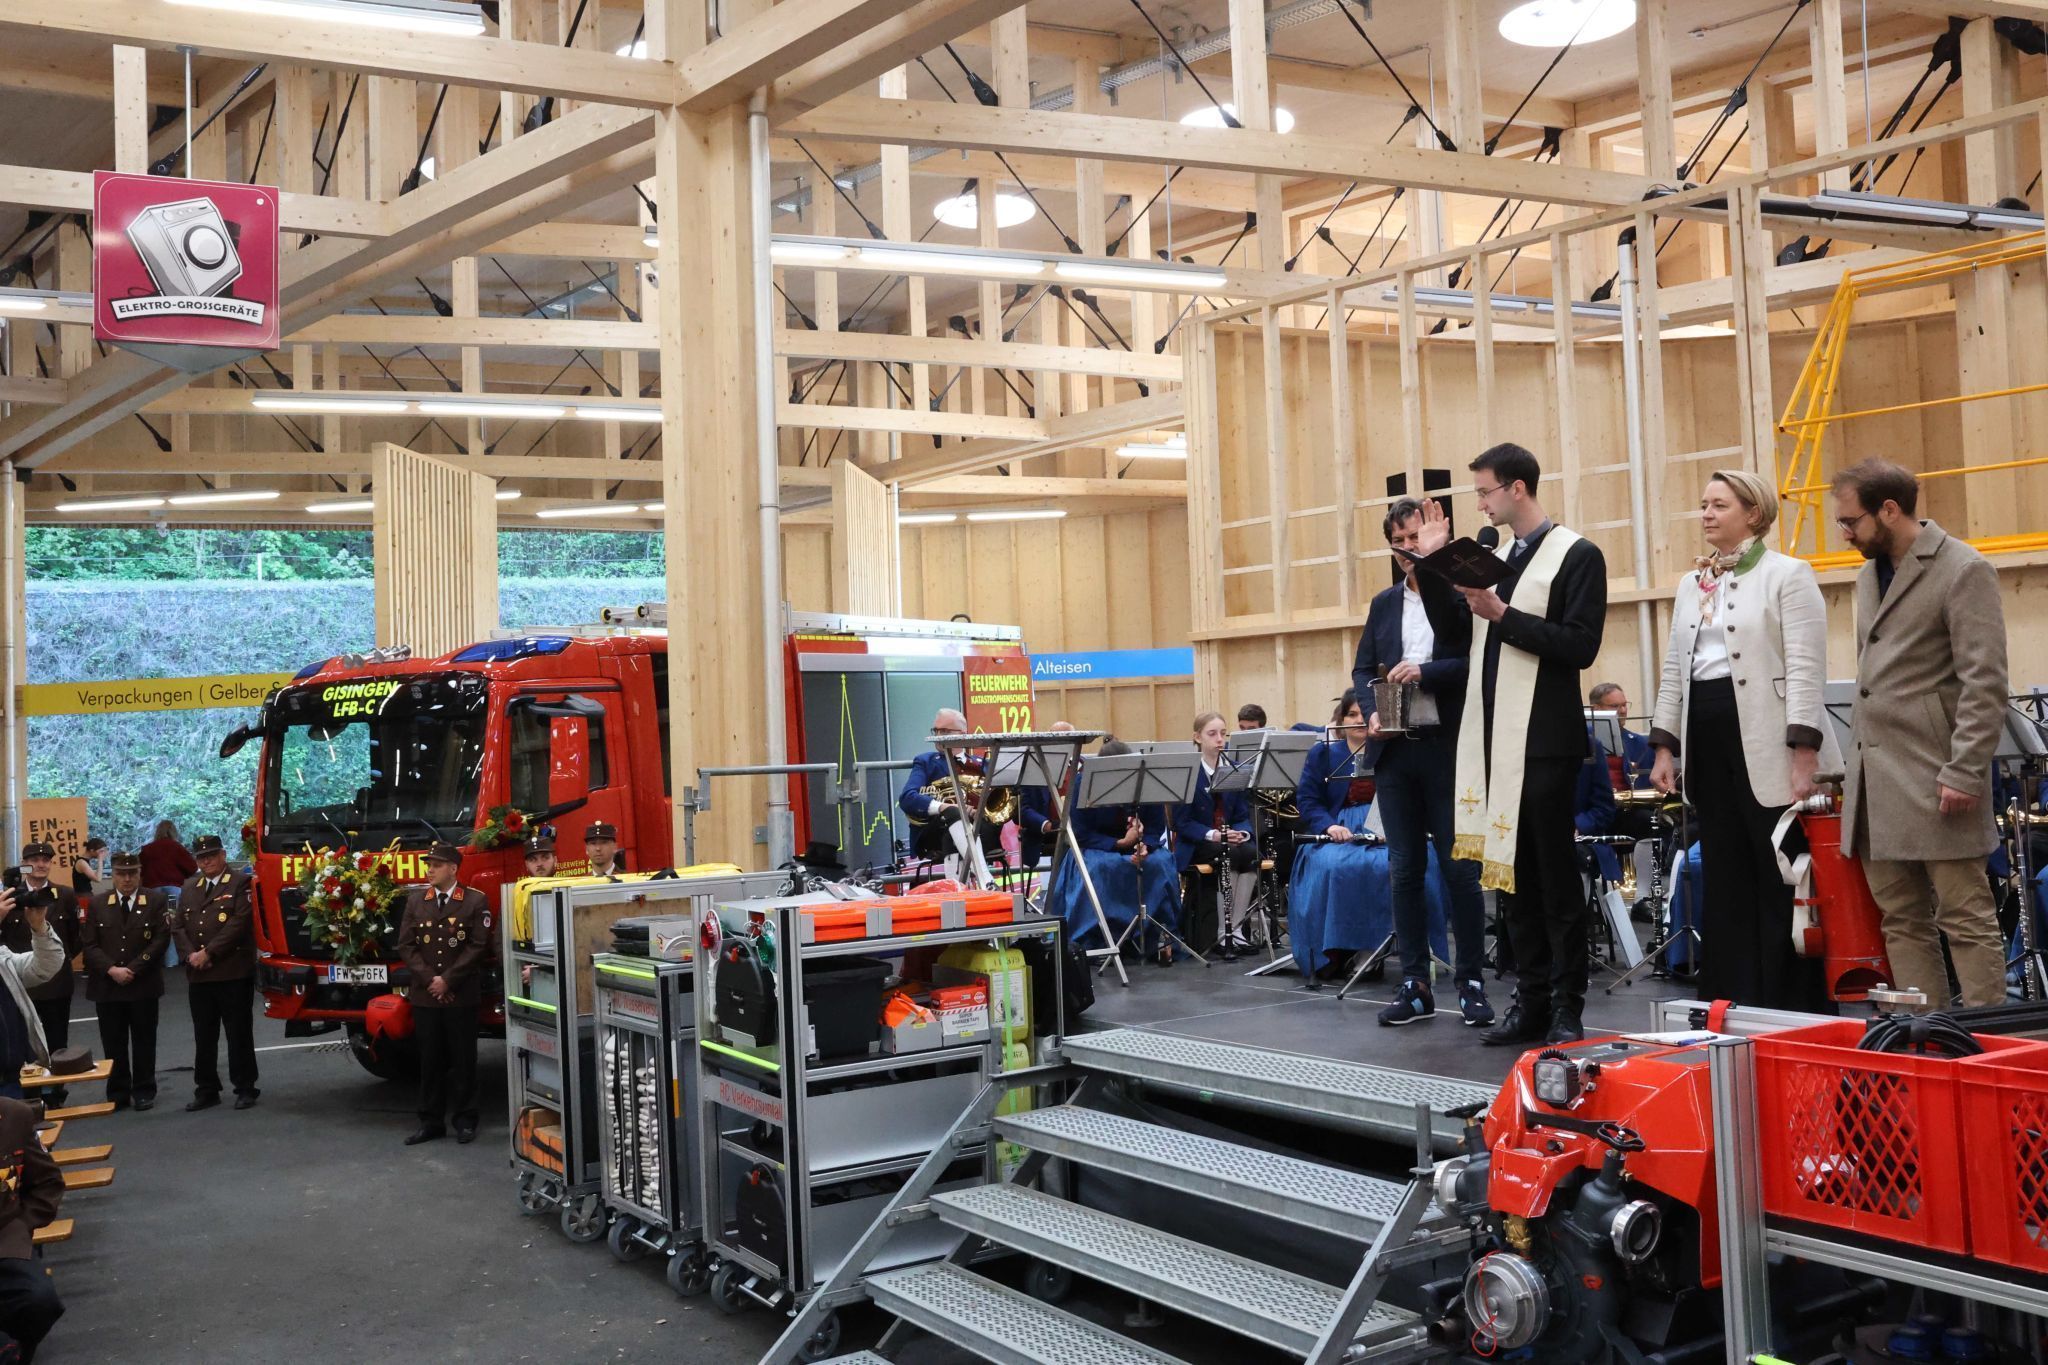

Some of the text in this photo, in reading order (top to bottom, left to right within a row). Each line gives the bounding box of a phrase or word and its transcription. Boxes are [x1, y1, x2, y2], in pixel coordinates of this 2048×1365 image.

[118, 300, 259, 318] ELEKTRO-GROSSGERÄTE
[1034, 660, 1092, 675] Alteisen
[322, 681, 398, 702] GISINGEN
[969, 675, 1028, 692] FEUERWEHR
[77, 688, 192, 709] Verpackungen
[210, 683, 266, 701] Gelber
[971, 694, 1029, 705] KATASTROPHENSCHUTZ
[333, 699, 376, 718] LFB-C
[1000, 706, 1032, 733] 122
[355, 967, 385, 981] 76FK
